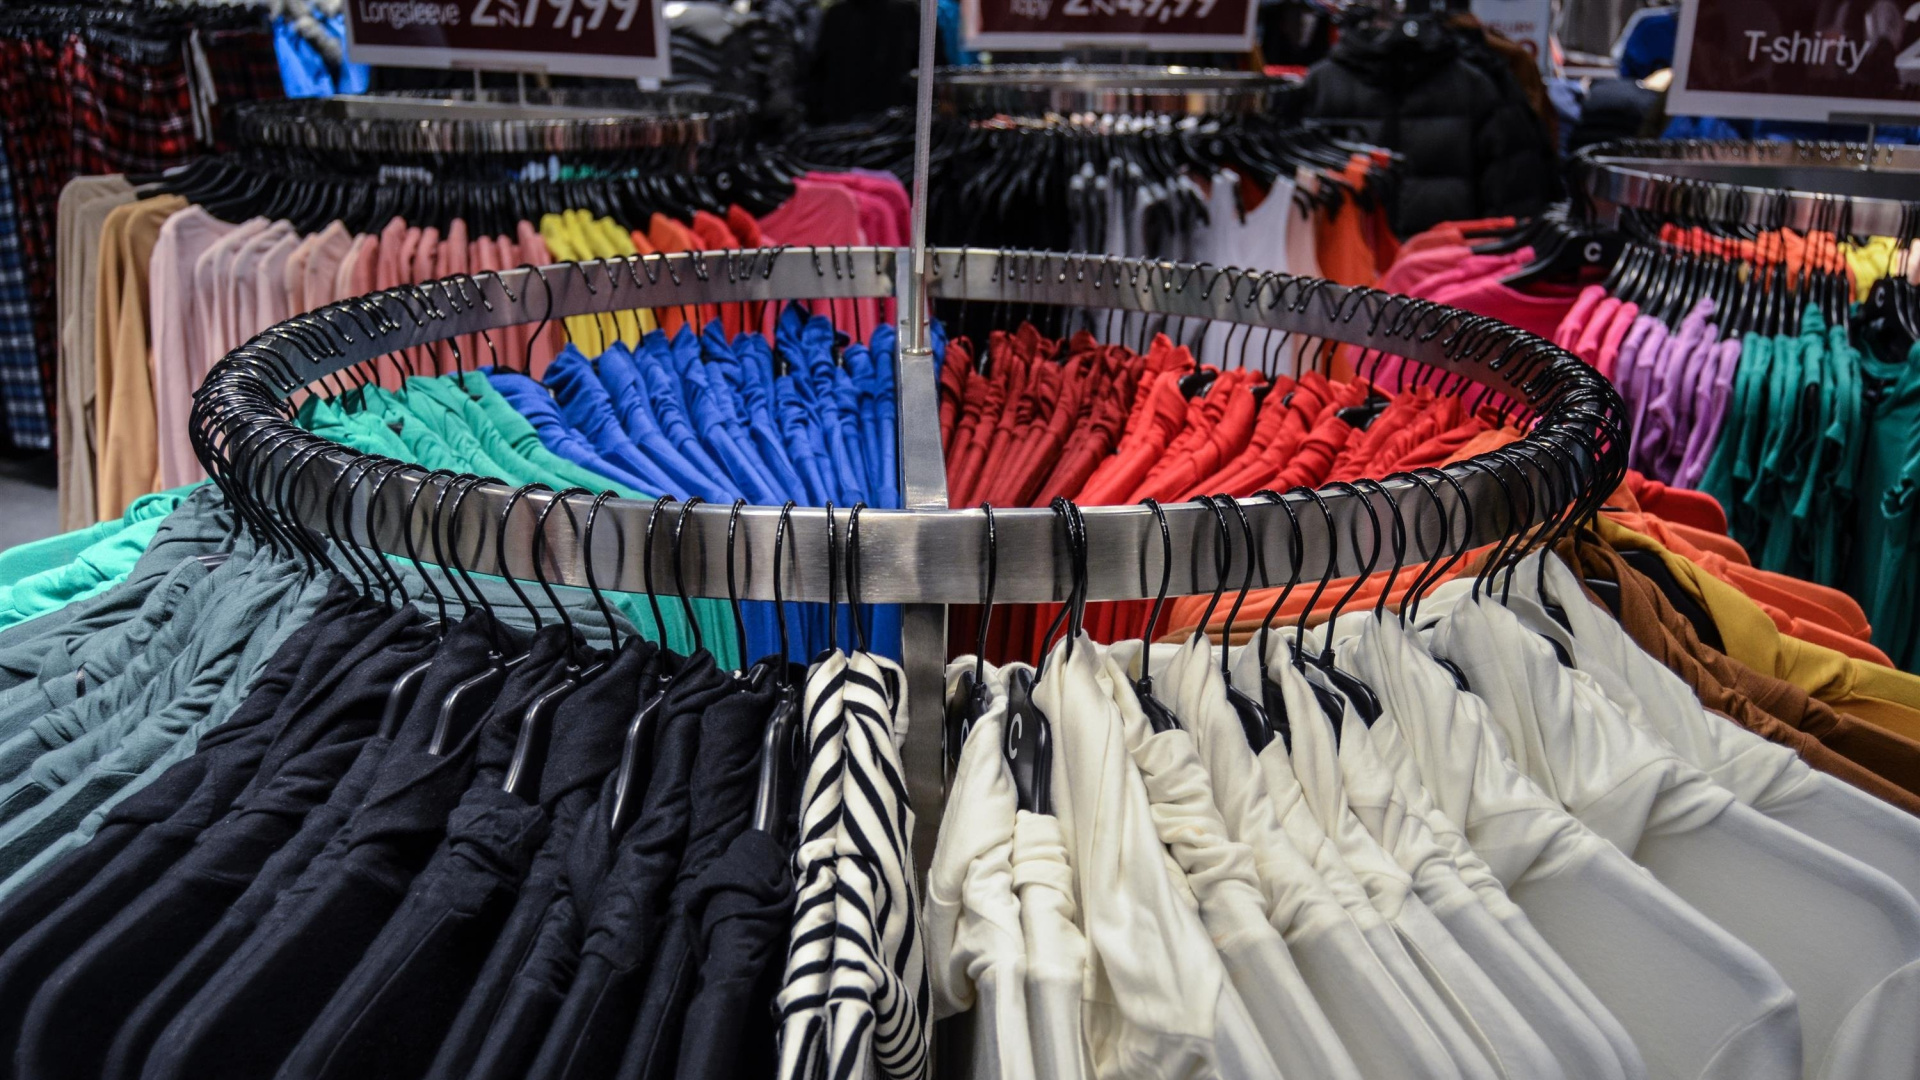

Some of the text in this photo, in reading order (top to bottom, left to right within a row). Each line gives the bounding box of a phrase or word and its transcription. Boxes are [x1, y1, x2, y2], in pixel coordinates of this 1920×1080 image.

[1744, 30, 1870, 74] T-shirty
[1584, 241, 1602, 262] C
[1008, 712, 1023, 760] C
